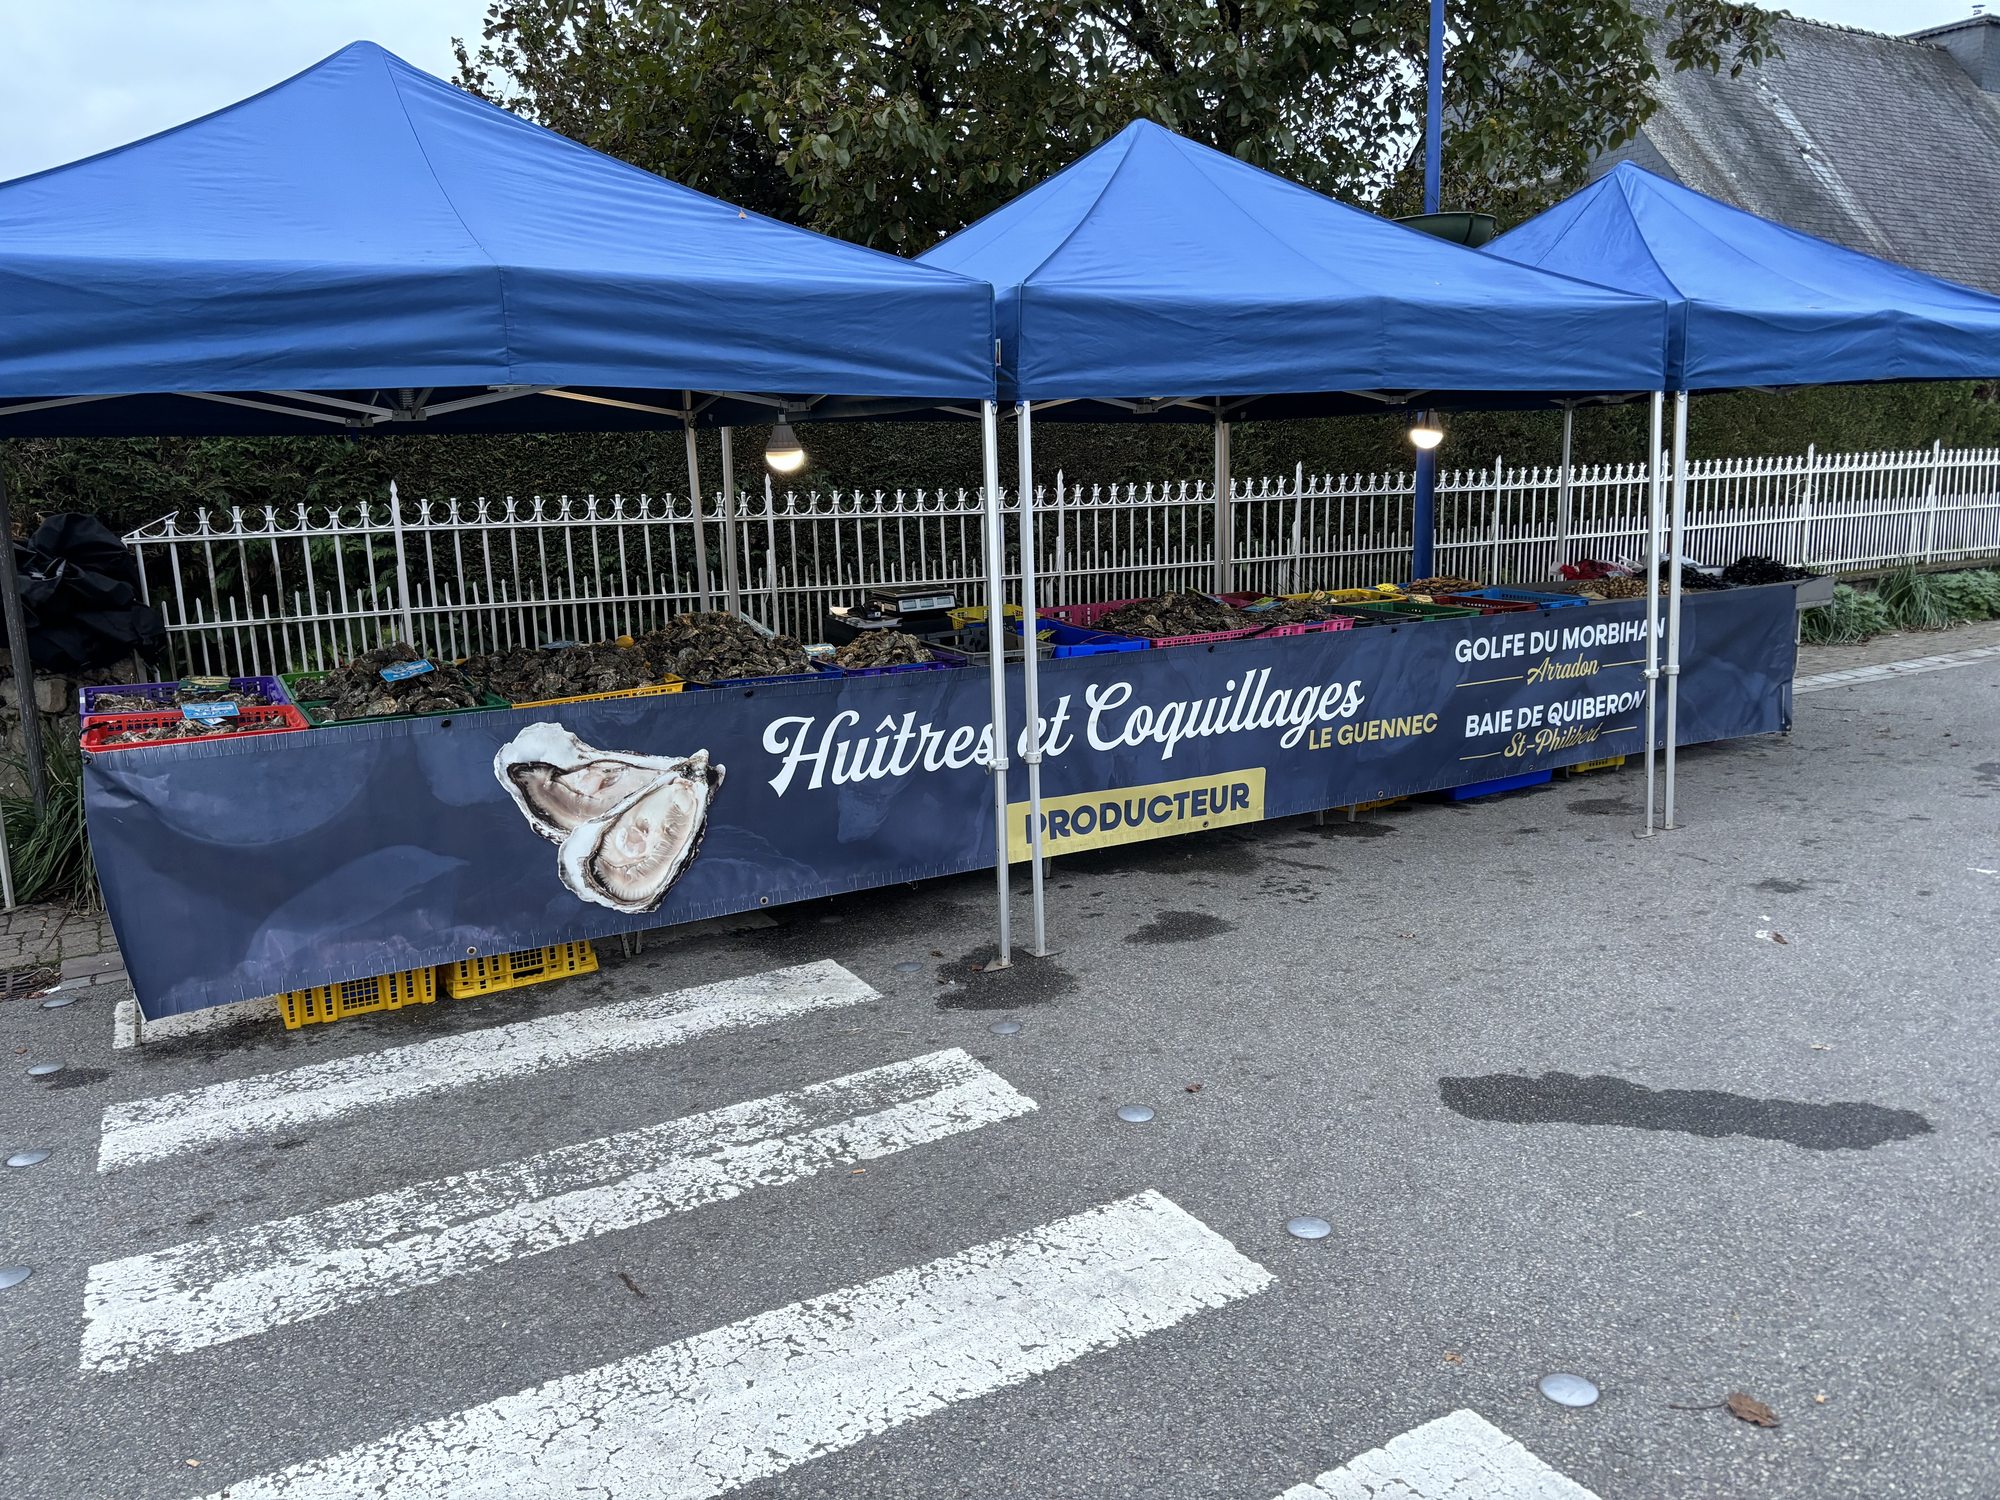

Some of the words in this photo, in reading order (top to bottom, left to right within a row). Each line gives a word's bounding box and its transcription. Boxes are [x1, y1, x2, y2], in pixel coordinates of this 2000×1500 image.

[1455, 634, 1525, 662] GOLFE
[1530, 629, 1556, 655] DU
[1527, 652, 1600, 685] Arradon
[763, 709, 995, 797] Huîtres
[1085, 666, 1366, 760] Coquillages
[1309, 728, 1332, 750] LE
[1337, 713, 1438, 744] GUENNEC
[1465, 711, 1511, 738] BAIE
[1516, 705, 1542, 730] DE
[1547, 690, 1646, 727] QUIBERON
[1504, 723, 1600, 758] St-Philibert
